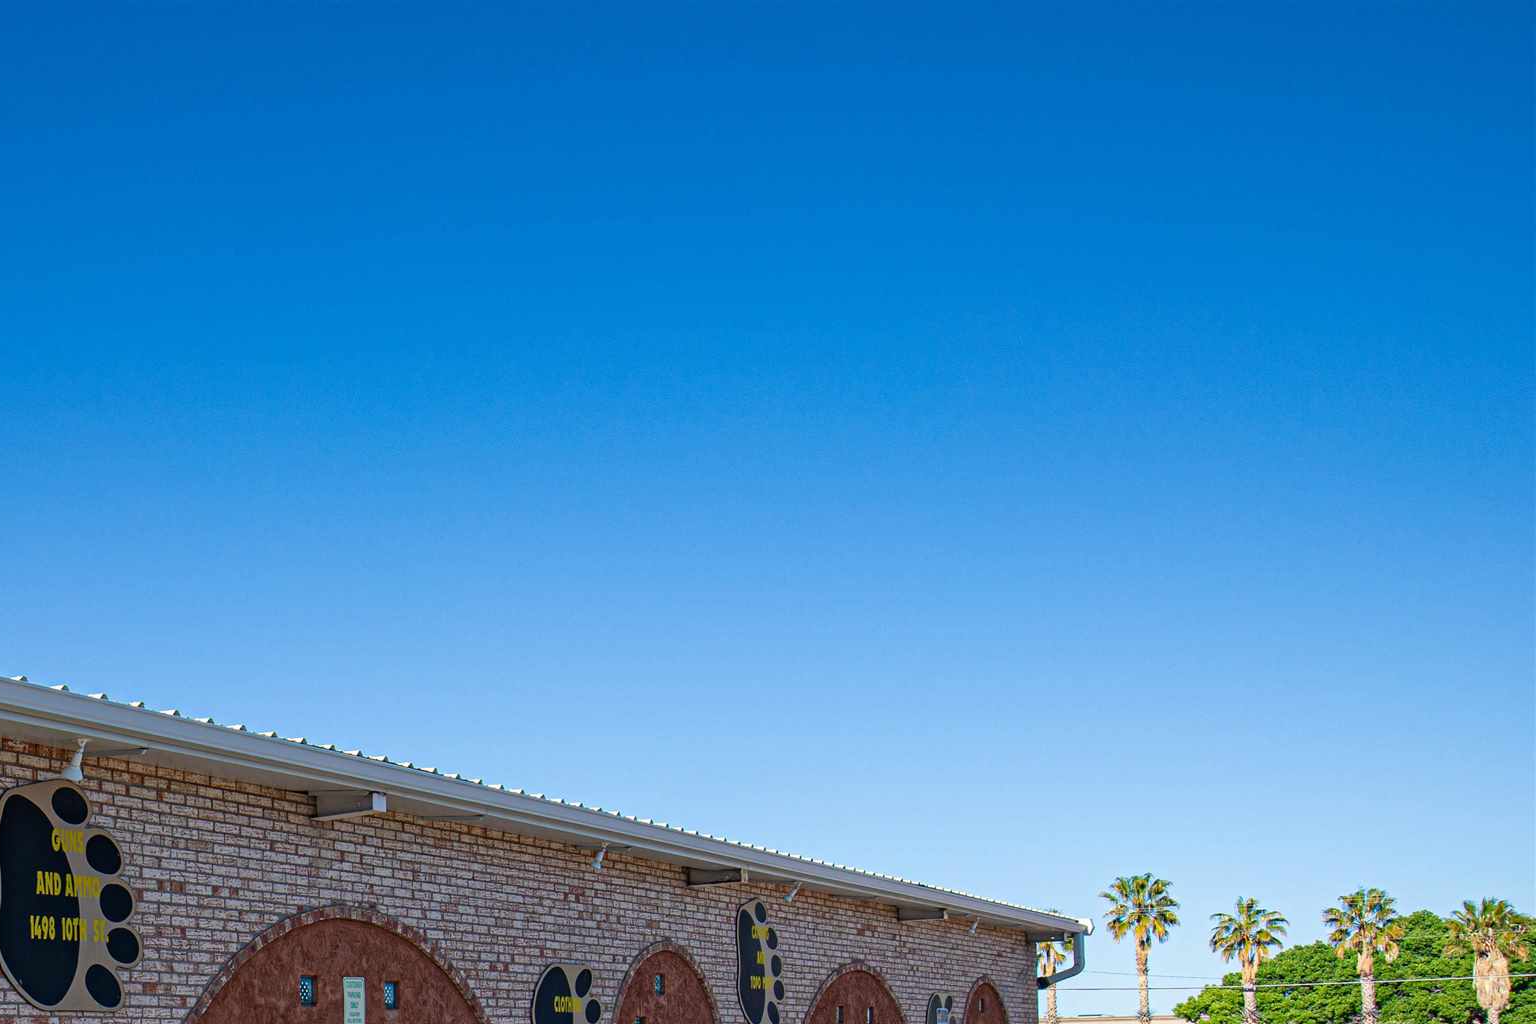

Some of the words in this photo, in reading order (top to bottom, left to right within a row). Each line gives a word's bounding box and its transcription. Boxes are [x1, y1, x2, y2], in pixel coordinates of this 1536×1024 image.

[52, 828, 84, 853] GUNS
[36, 870, 62, 897] AND
[65, 873, 102, 898] AMMO
[30, 915, 56, 941] 1498
[61, 916, 88, 942] 10TH
